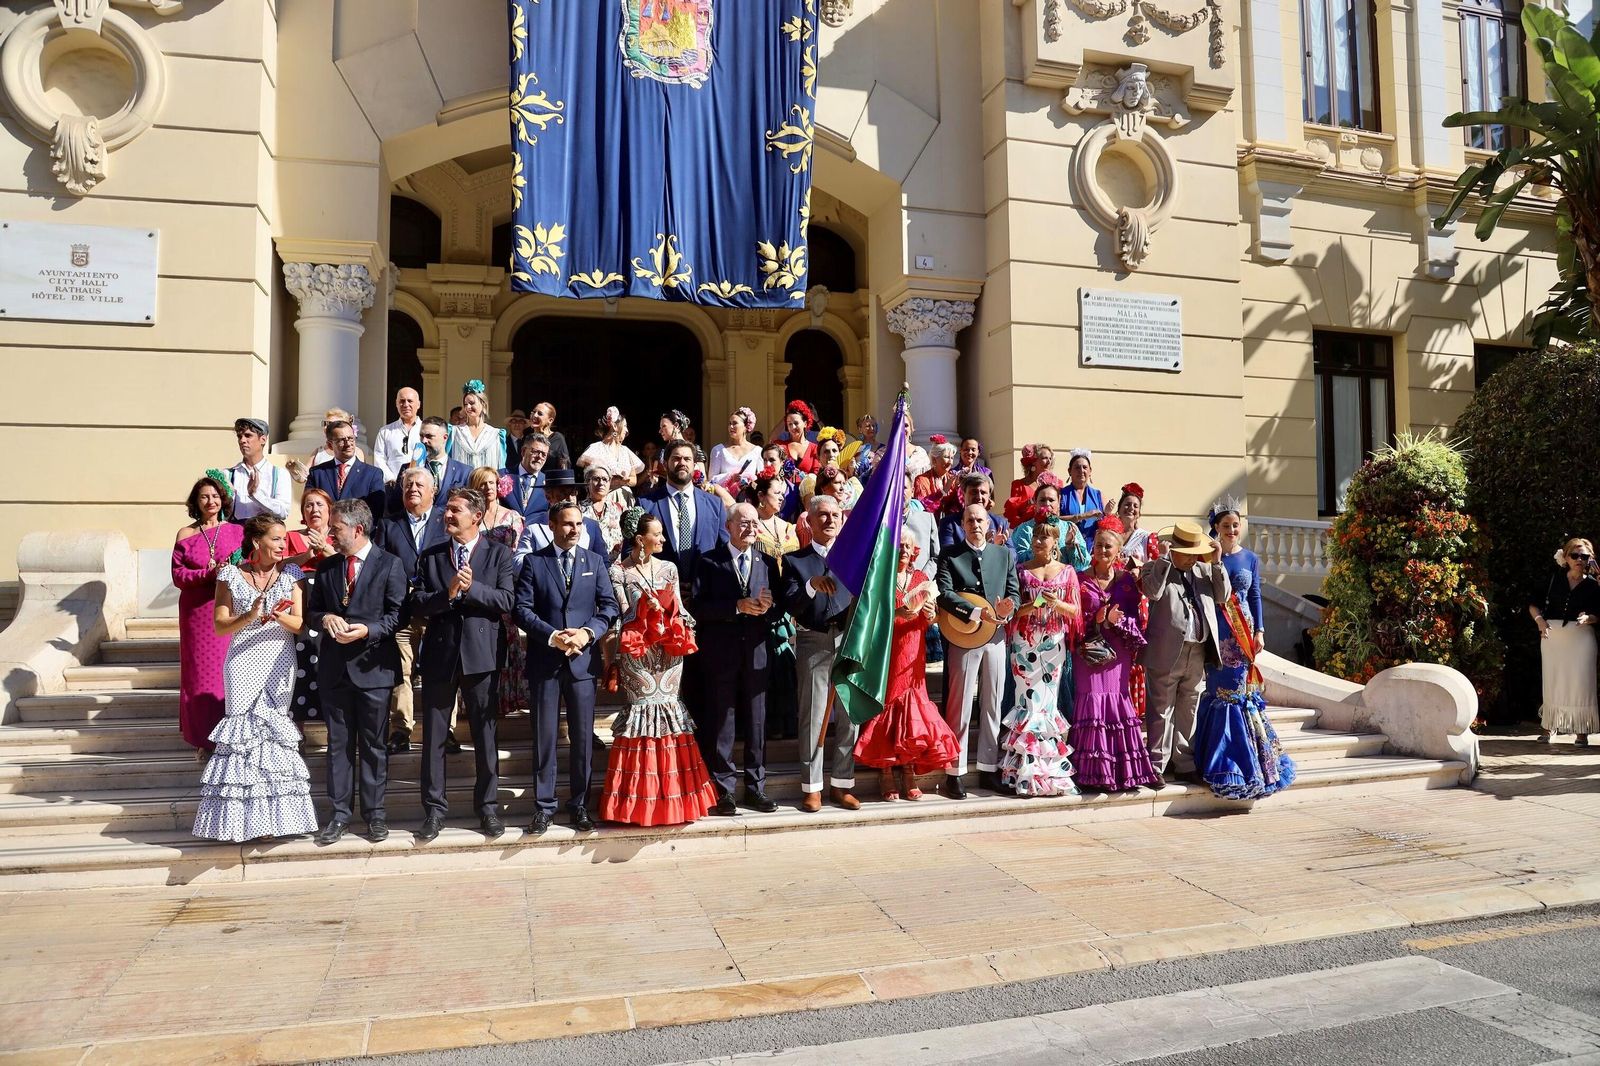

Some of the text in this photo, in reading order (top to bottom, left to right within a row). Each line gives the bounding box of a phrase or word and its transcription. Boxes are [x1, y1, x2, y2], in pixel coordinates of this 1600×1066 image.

[38, 269, 119, 279] AYUNTAMIENTO
[49, 277, 108, 287] CITY HALL
[55, 286, 102, 294] RATHAUS
[31, 291, 66, 301] HÔTEL
[91, 295, 124, 303] VILLE
[1116, 309, 1148, 319] MALAGA
